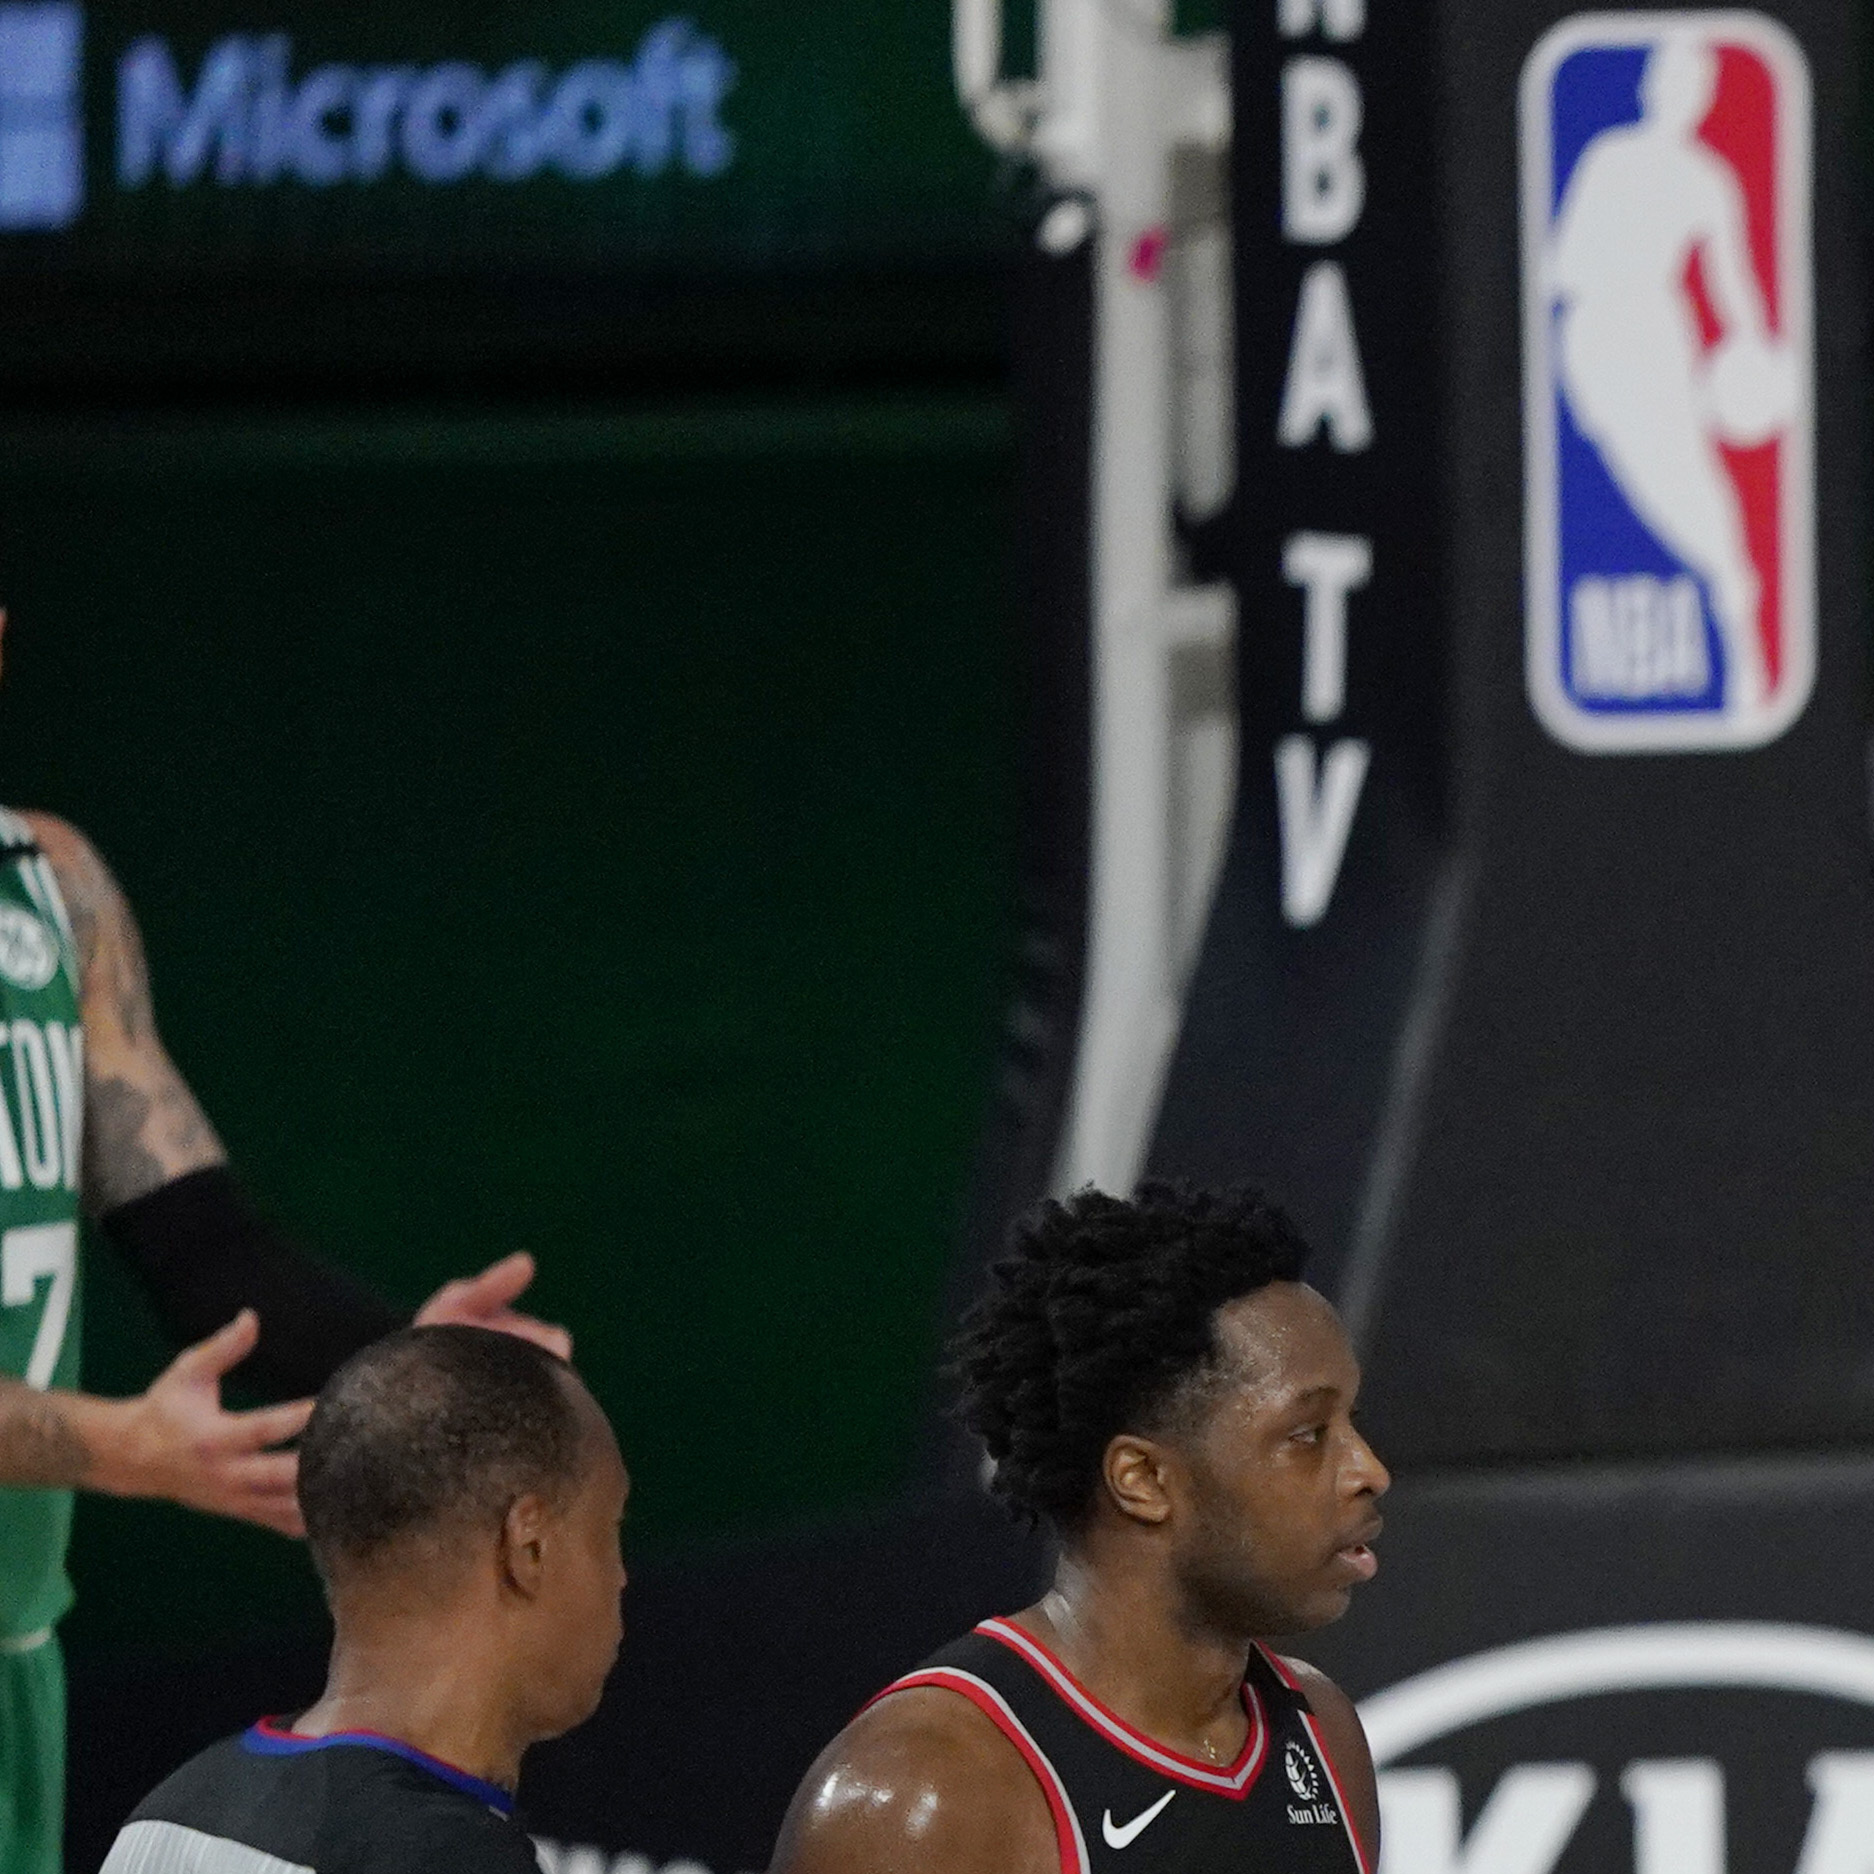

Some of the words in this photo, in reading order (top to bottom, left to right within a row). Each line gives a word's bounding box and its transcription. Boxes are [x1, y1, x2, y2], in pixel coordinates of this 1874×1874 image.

[116, 18, 737, 188] Microsoft
[1277, 0, 1374, 452] BA
[1275, 533, 1372, 927] TV
[1286, 1803, 1314, 1824] Sun
[1312, 1803, 1338, 1825] Life
